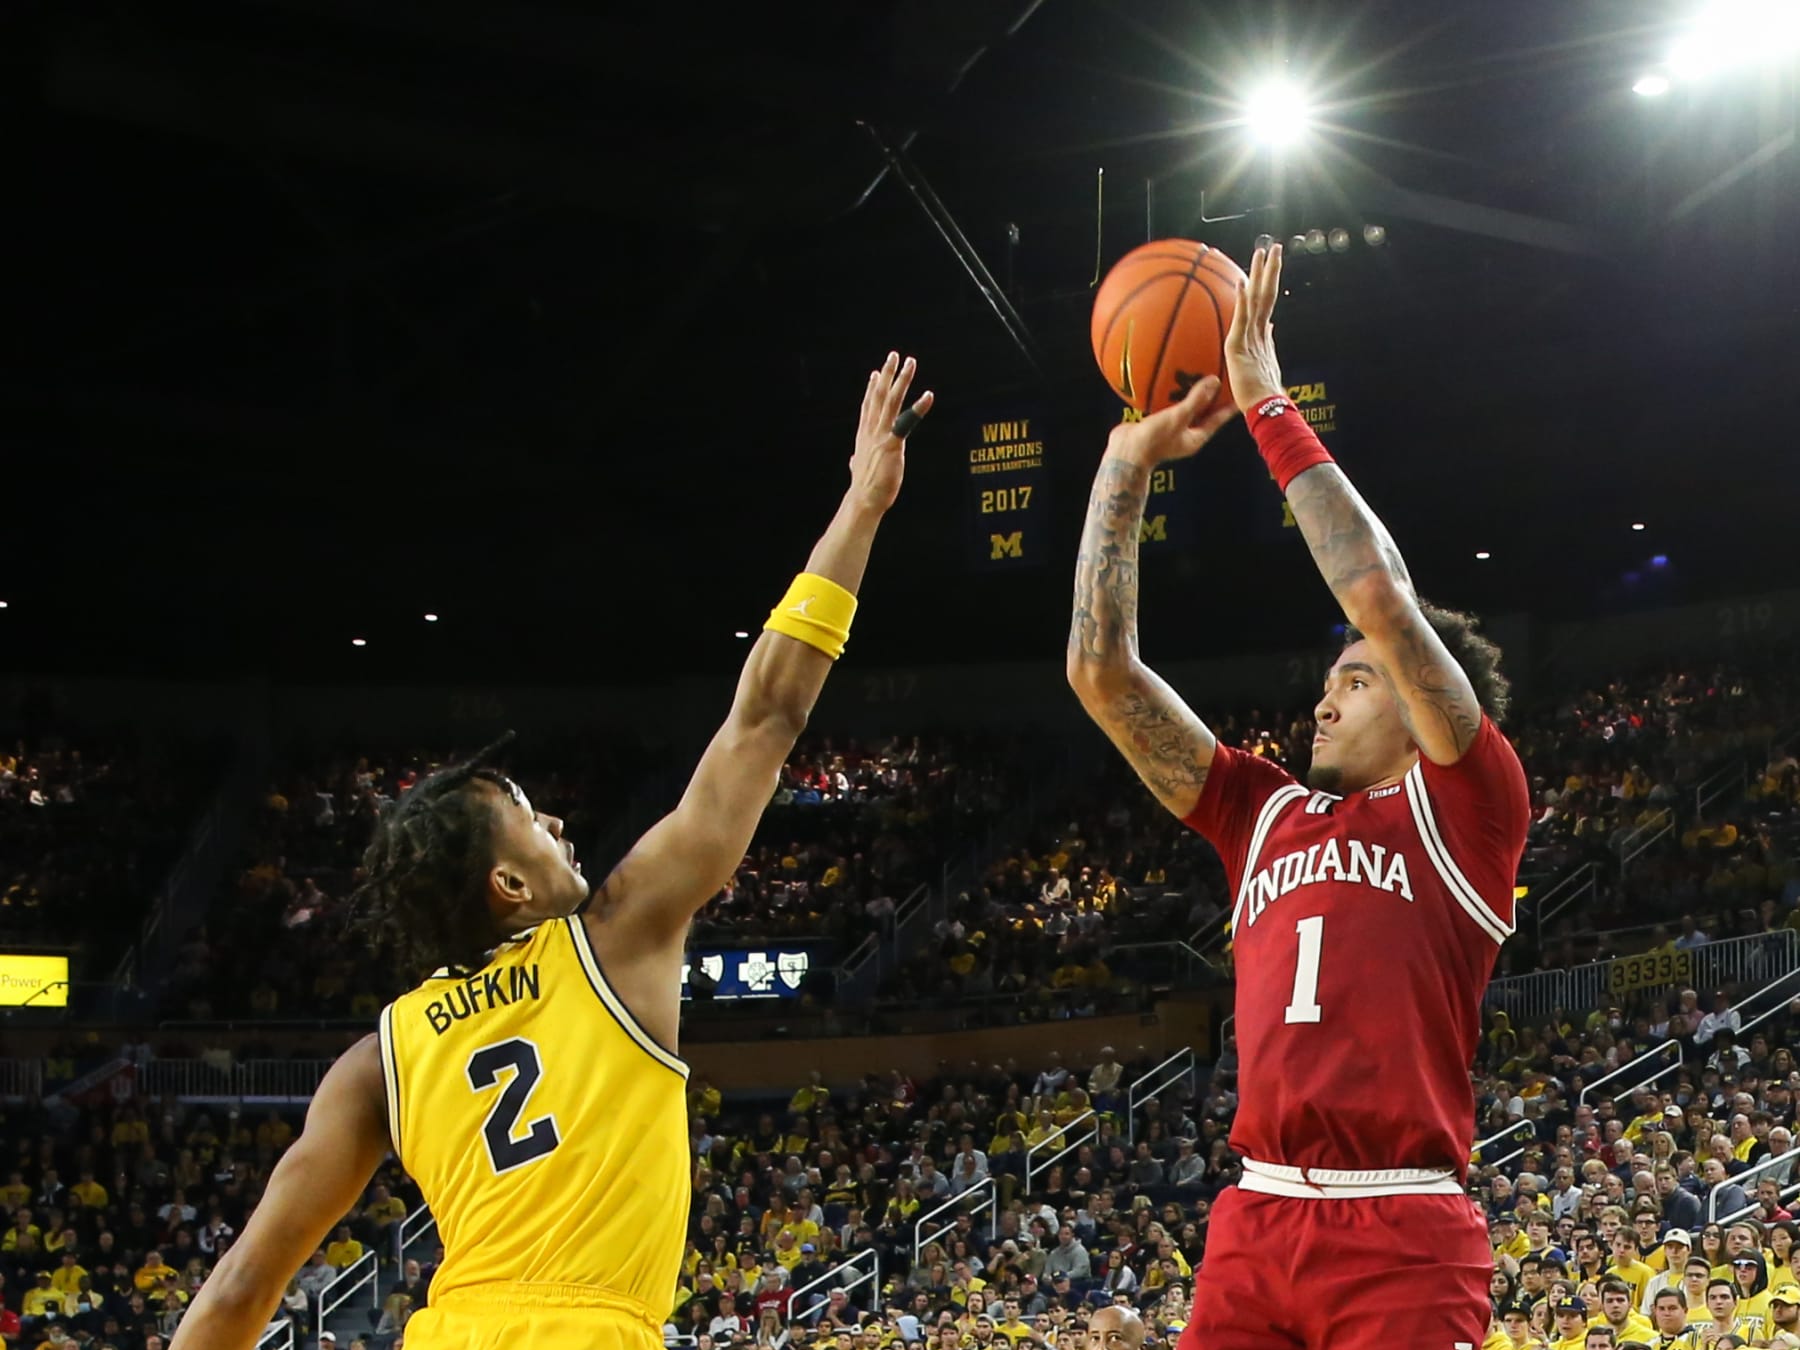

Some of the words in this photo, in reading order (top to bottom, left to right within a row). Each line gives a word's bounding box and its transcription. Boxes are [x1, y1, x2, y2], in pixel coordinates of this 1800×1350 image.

[983, 419, 1029, 443] WNIT
[970, 441, 1043, 463] CHAMPIONS
[981, 486, 1032, 513] 2017
[991, 531, 1023, 560] M
[1246, 837, 1415, 928] INDIANA
[1283, 915, 1325, 1025] 1
[1612, 953, 1690, 989] 33333
[424, 963, 541, 1037] BUFKIN
[464, 1035, 563, 1177] 2
